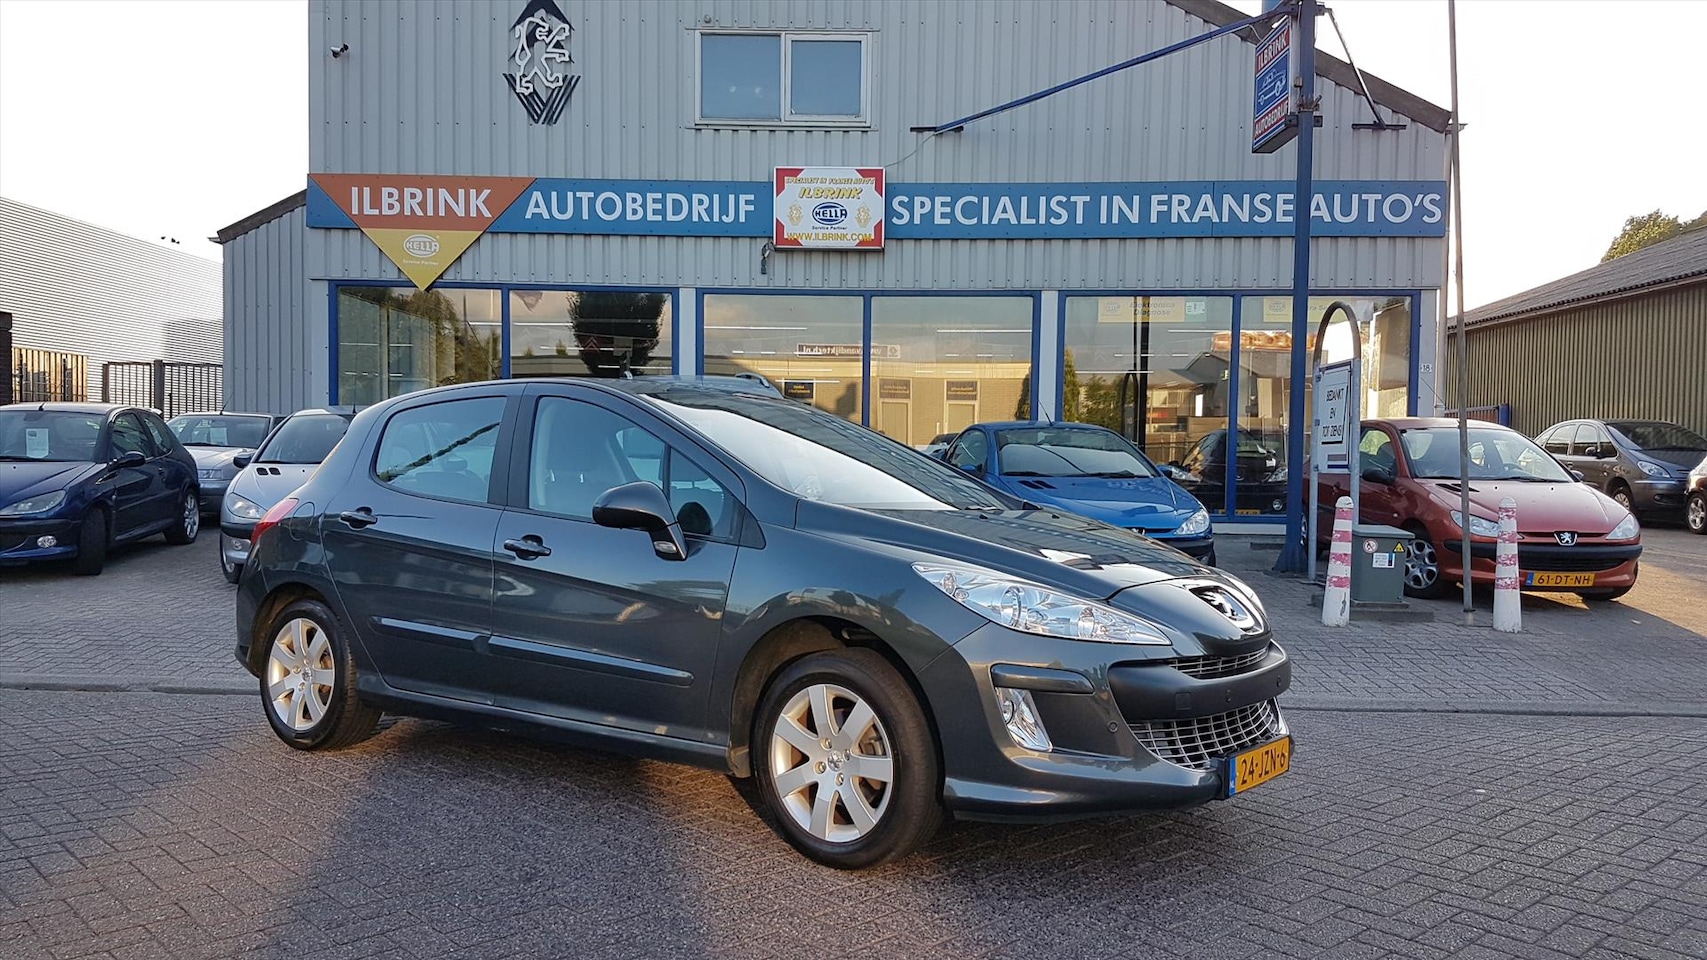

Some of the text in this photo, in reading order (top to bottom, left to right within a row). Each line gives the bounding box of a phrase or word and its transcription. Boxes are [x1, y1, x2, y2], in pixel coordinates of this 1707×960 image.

[1258, 30, 1287, 70] ILBRINK
[1254, 100, 1288, 138] AUTOBEDRIJF
[799, 187, 863, 199] ILBRINK
[350, 186, 492, 218] ILBRINK
[525, 190, 755, 223] AUTOBEDRIJF
[891, 193, 1443, 225] SPECIALIST IN FRANSE AUTO'S
[786, 232, 873, 242] WWW.ILBRINK.COM
[1422, 364, 1431, 372] 18
[1326, 388, 1344, 401] BEDANKT
[1329, 407, 1337, 419] EN
[1322, 424, 1342, 438] TOT ZIENS
[1537, 574, 1591, 585] 61-DT-NH
[1240, 743, 1287, 786] 24-JZN-6
